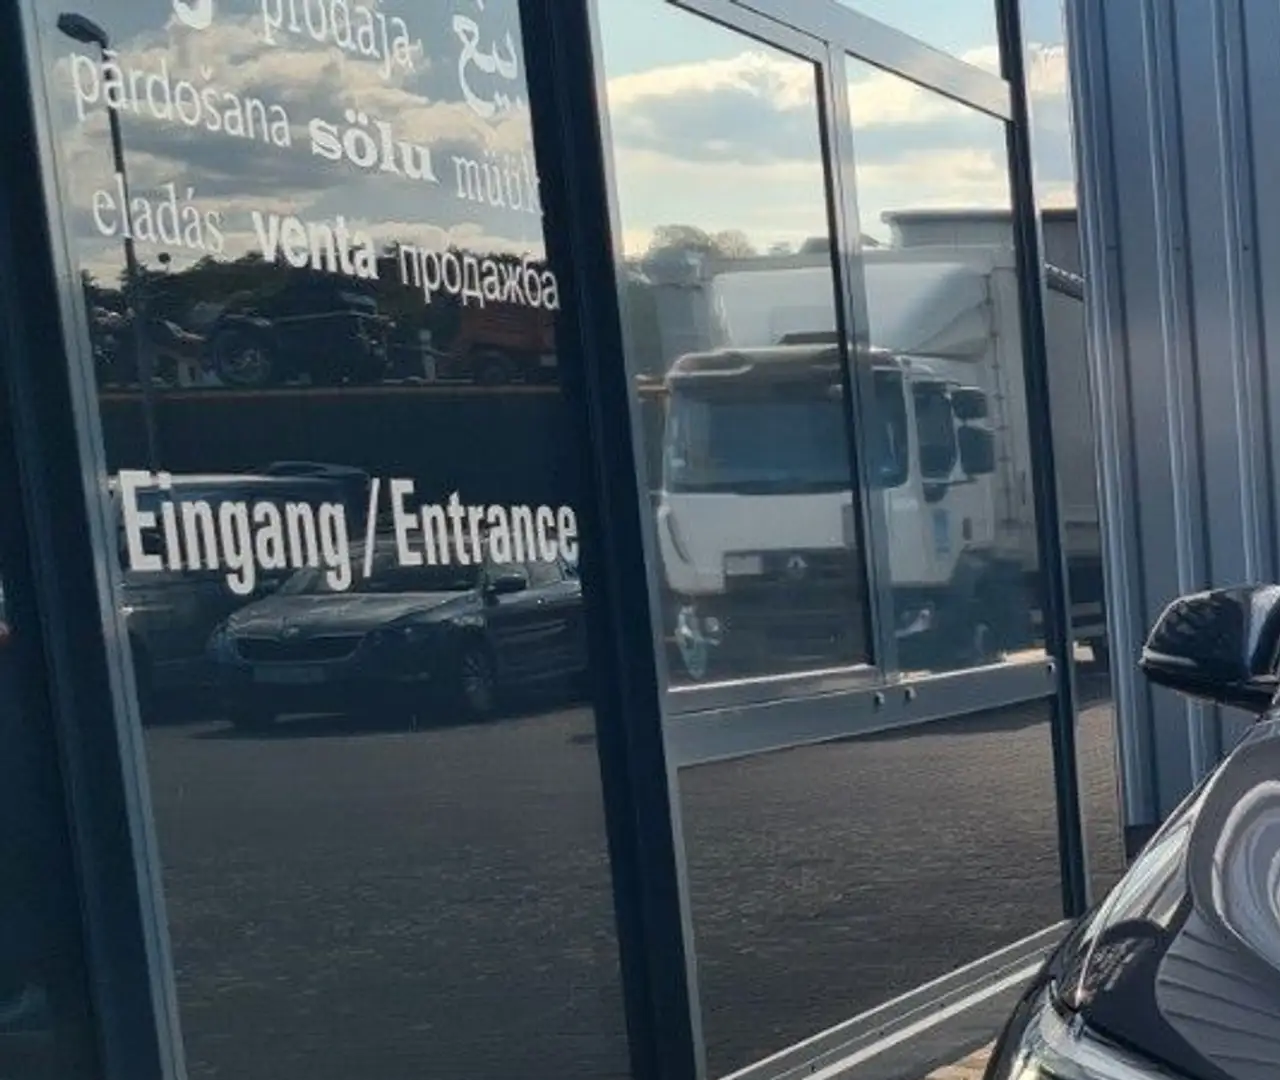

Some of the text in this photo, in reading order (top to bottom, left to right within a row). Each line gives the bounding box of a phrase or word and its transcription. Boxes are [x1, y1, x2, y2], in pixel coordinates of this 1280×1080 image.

[308, 109, 441, 185] sölu
[91, 173, 560, 311] eladás venta продажба
[117, 469, 352, 595] Eingang
[392, 479, 579, 567] Entrance
